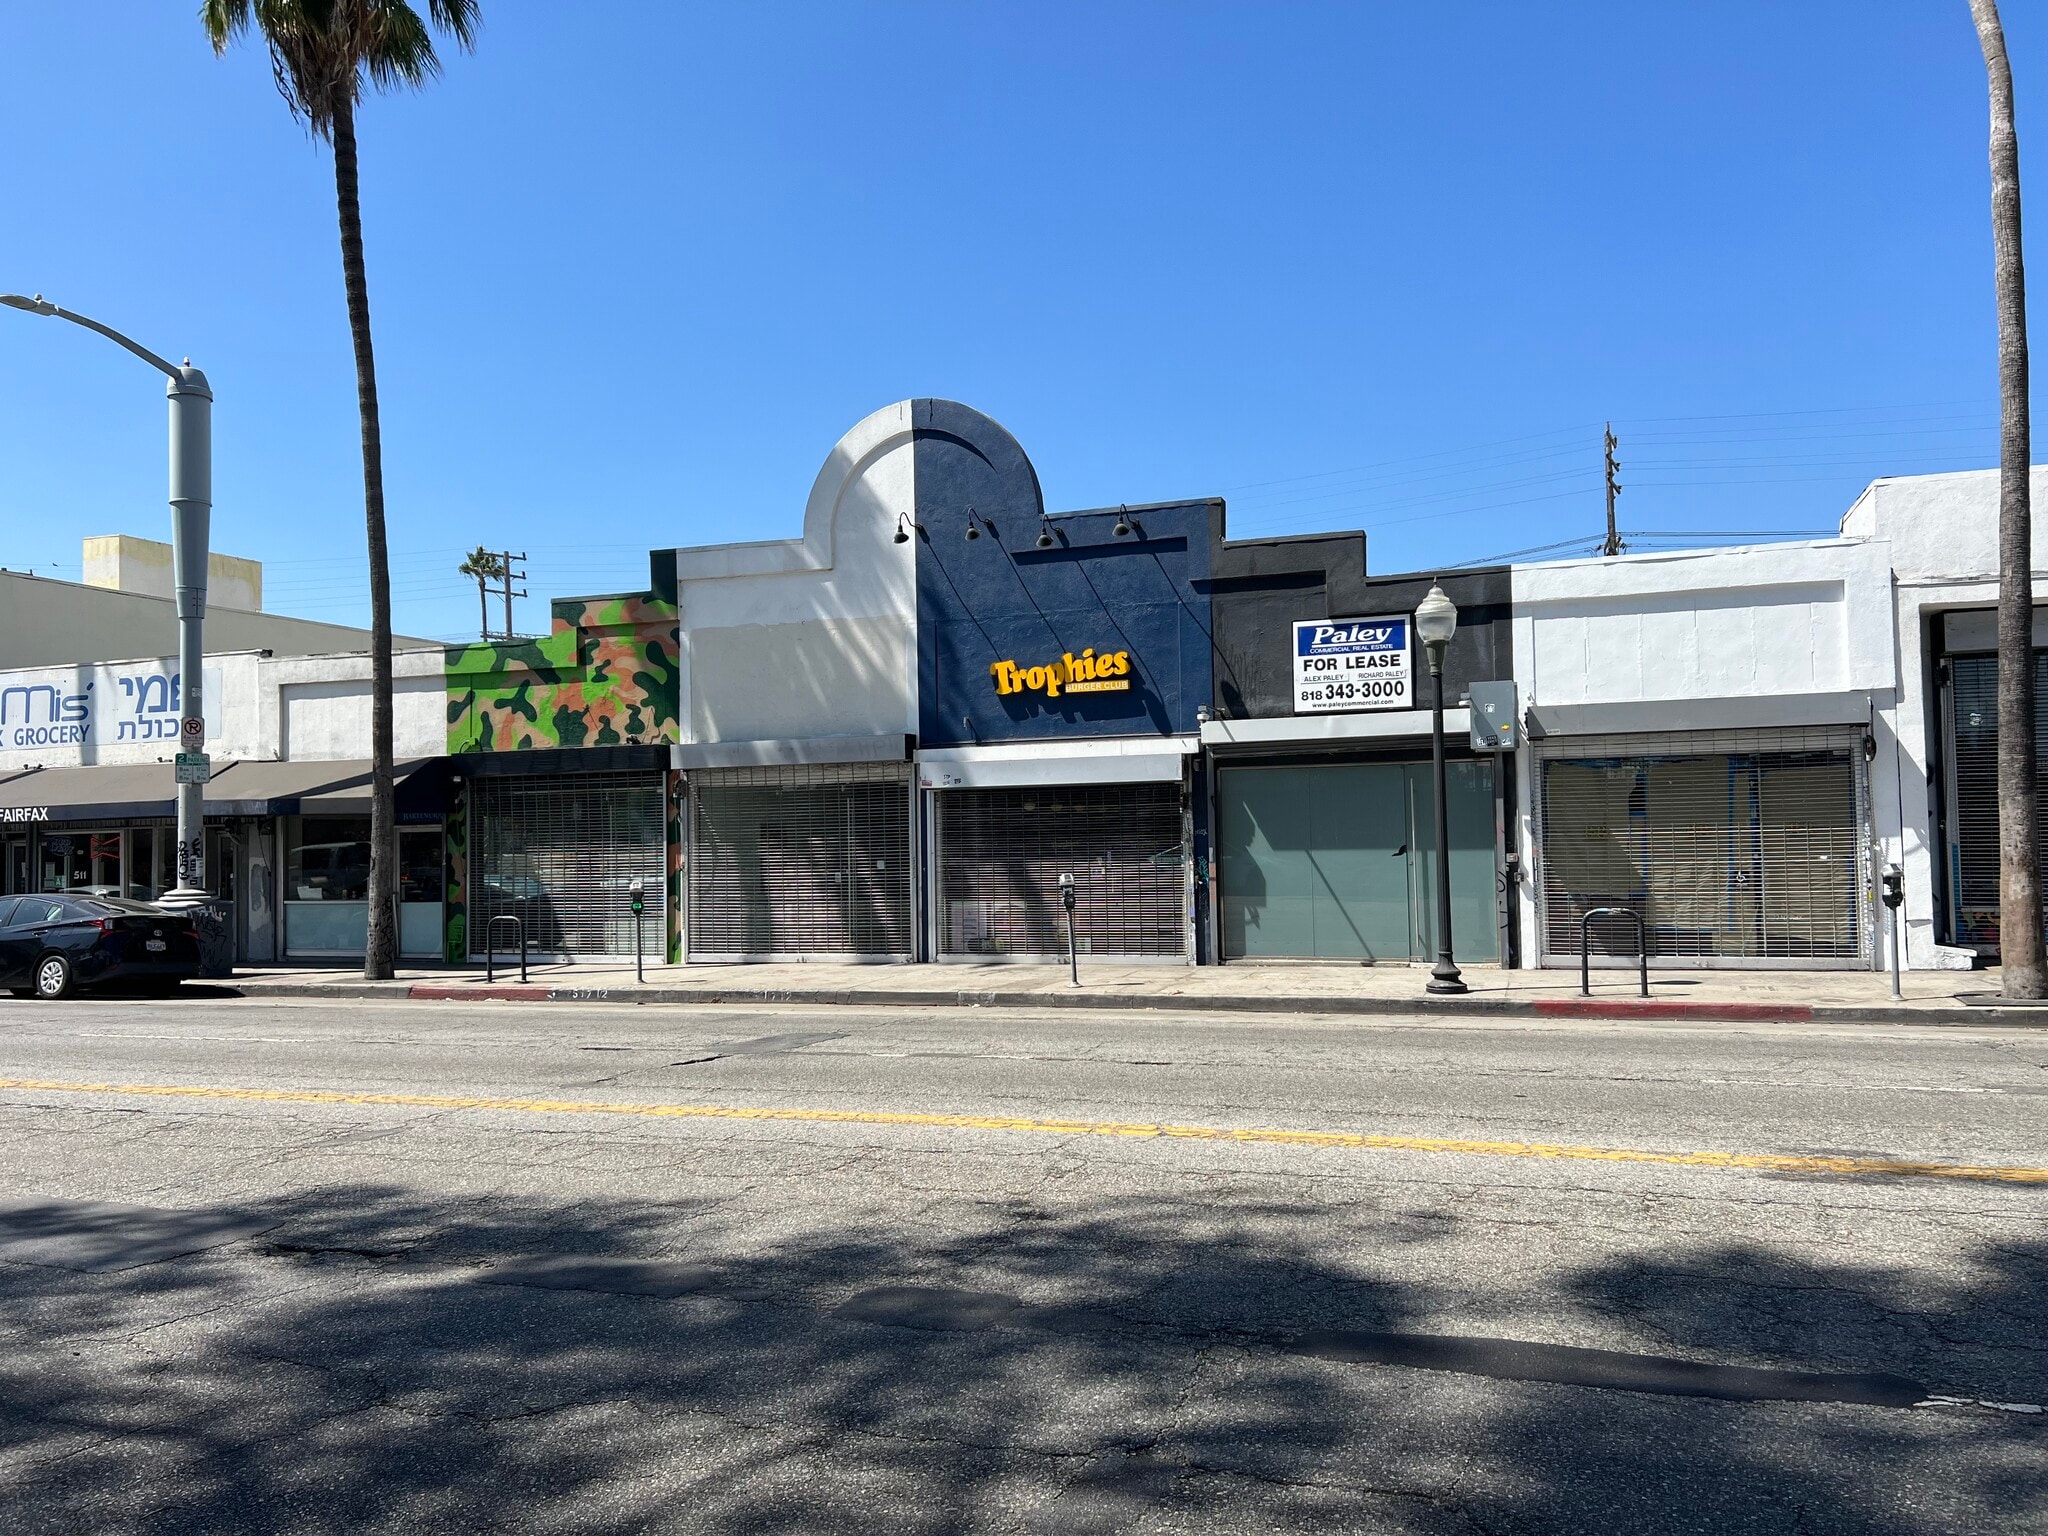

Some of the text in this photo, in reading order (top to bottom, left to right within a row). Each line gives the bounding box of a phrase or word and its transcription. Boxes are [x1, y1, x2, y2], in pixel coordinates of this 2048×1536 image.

[1311, 625, 1392, 645] Paley
[1310, 646, 1350, 654] COMMERCIAL
[990, 648, 1130, 696] Trophies
[1303, 654, 1400, 672] FOR LEASE
[1066, 681, 1128, 691] BURGER CLUB
[1301, 681, 1404, 701] 818 343-3000
[1312, 700, 1394, 709] www.paleycommercial.com
[14, 724, 91, 746] GROCERY
[73, 870, 87, 880] 511
